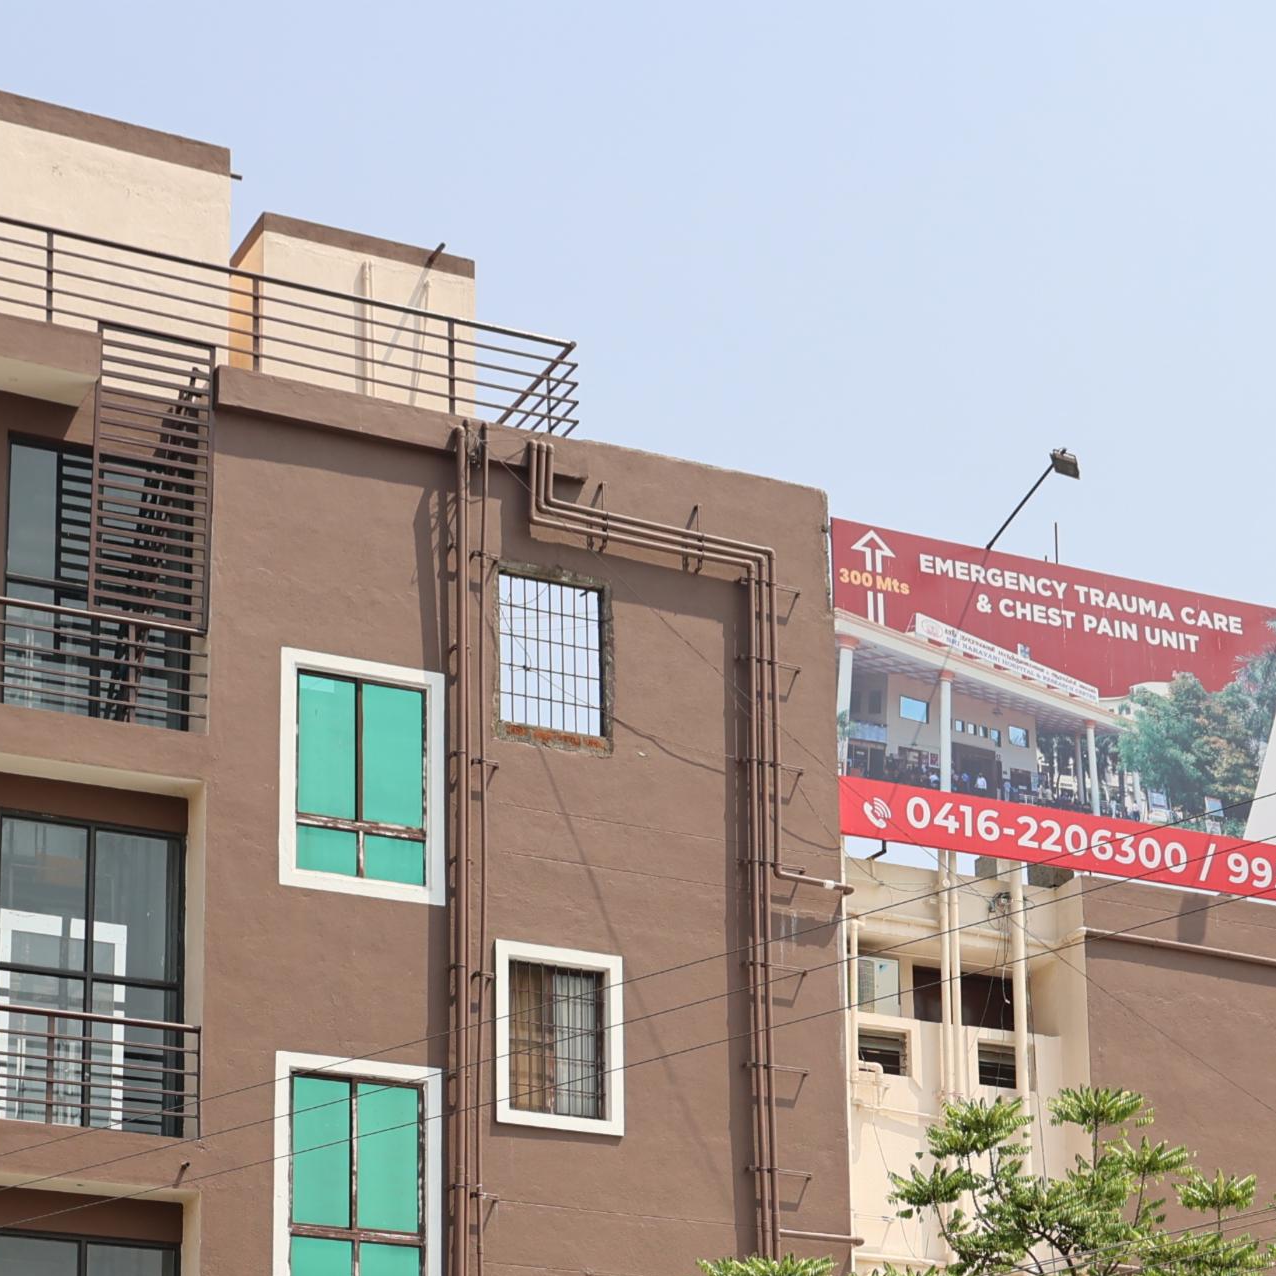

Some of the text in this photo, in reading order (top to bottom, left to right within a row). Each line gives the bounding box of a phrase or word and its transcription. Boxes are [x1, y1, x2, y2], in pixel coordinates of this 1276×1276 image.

[839, 568, 910, 595] 300 Mts
[919, 553, 1243, 635] EMERGENCY TRAUMA CARE
[976, 594, 1199, 653] & CHEST PAIN UNIT
[905, 795, 1189, 875] 0416-2206300
[1198, 844, 1217, 881] /
